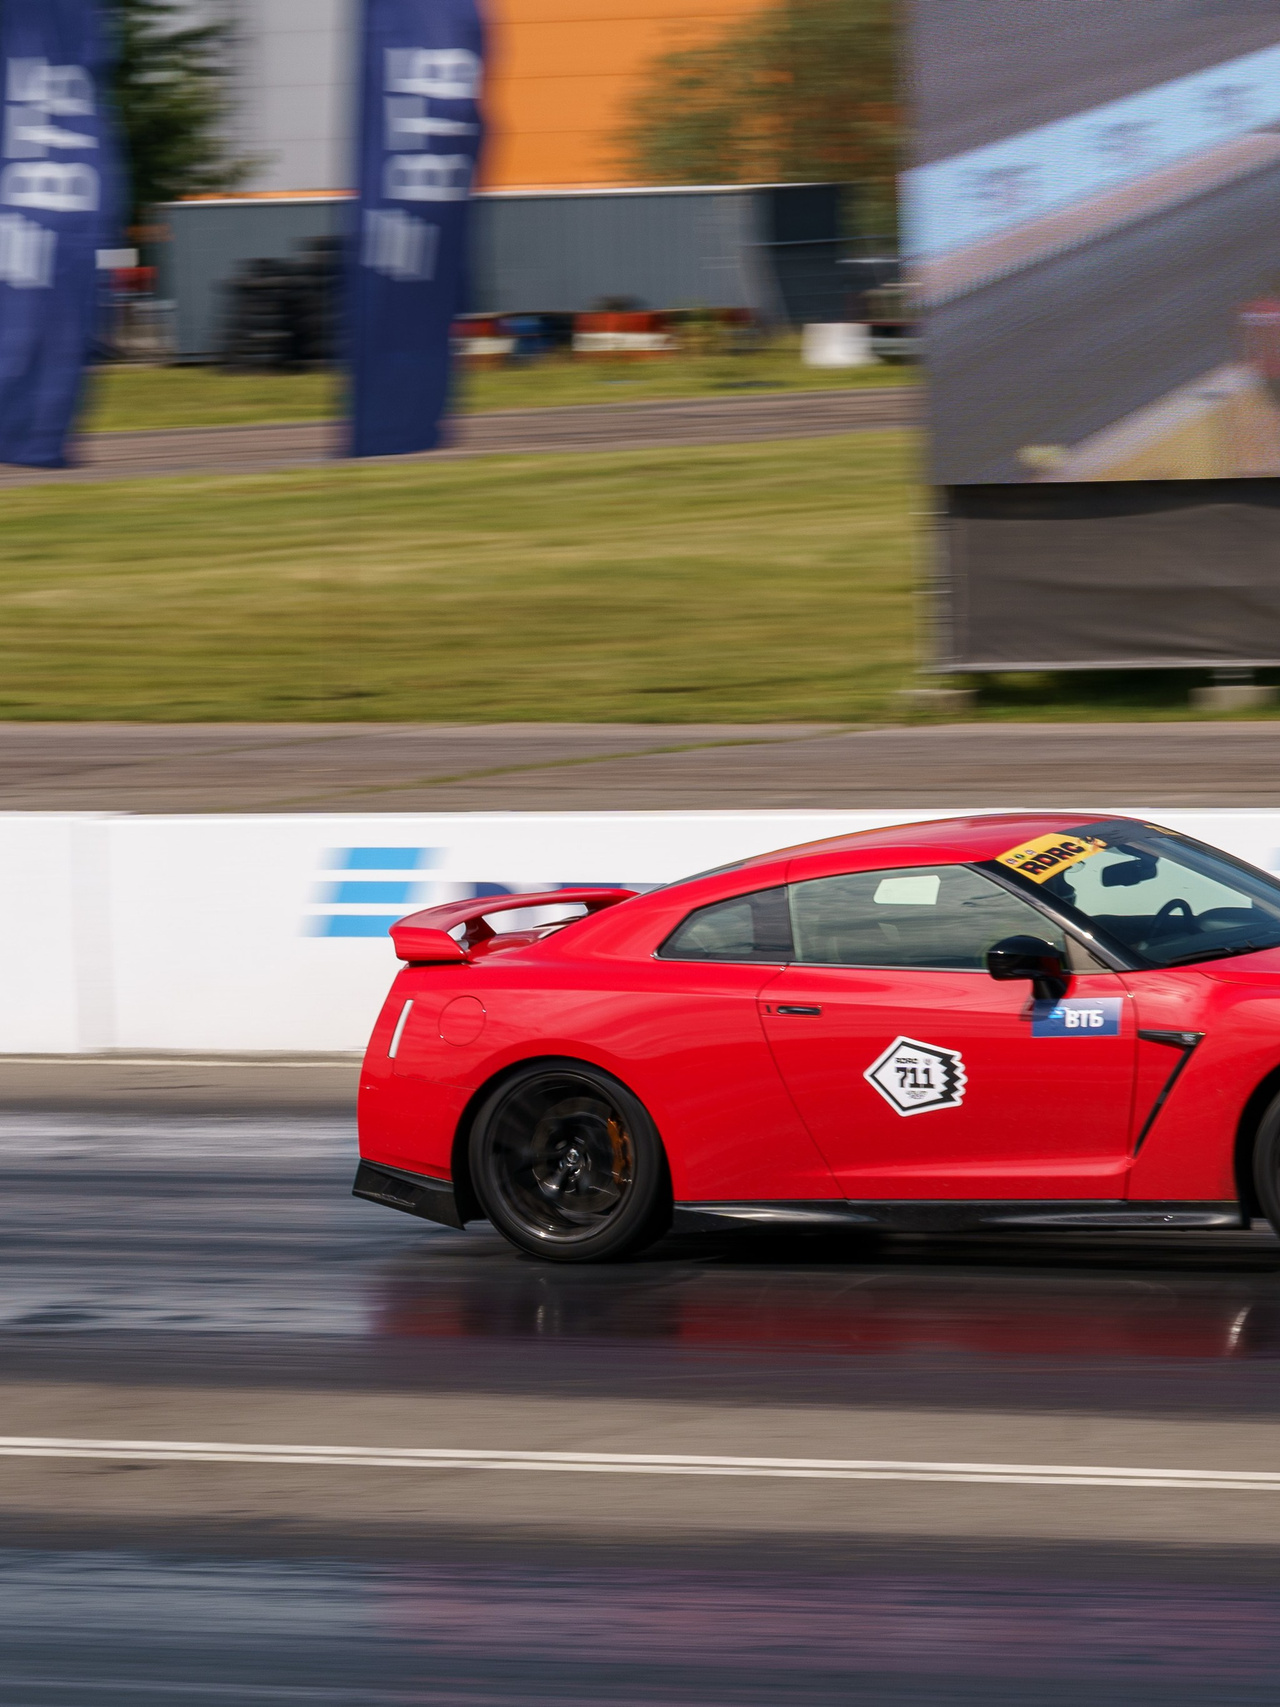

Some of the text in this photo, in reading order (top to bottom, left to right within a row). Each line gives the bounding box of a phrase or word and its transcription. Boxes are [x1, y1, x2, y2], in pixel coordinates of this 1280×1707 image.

[1017, 842, 1086, 875] RDRC
[1064, 1009, 1105, 1028] ВТБ
[895, 1066, 935, 1089] 711
